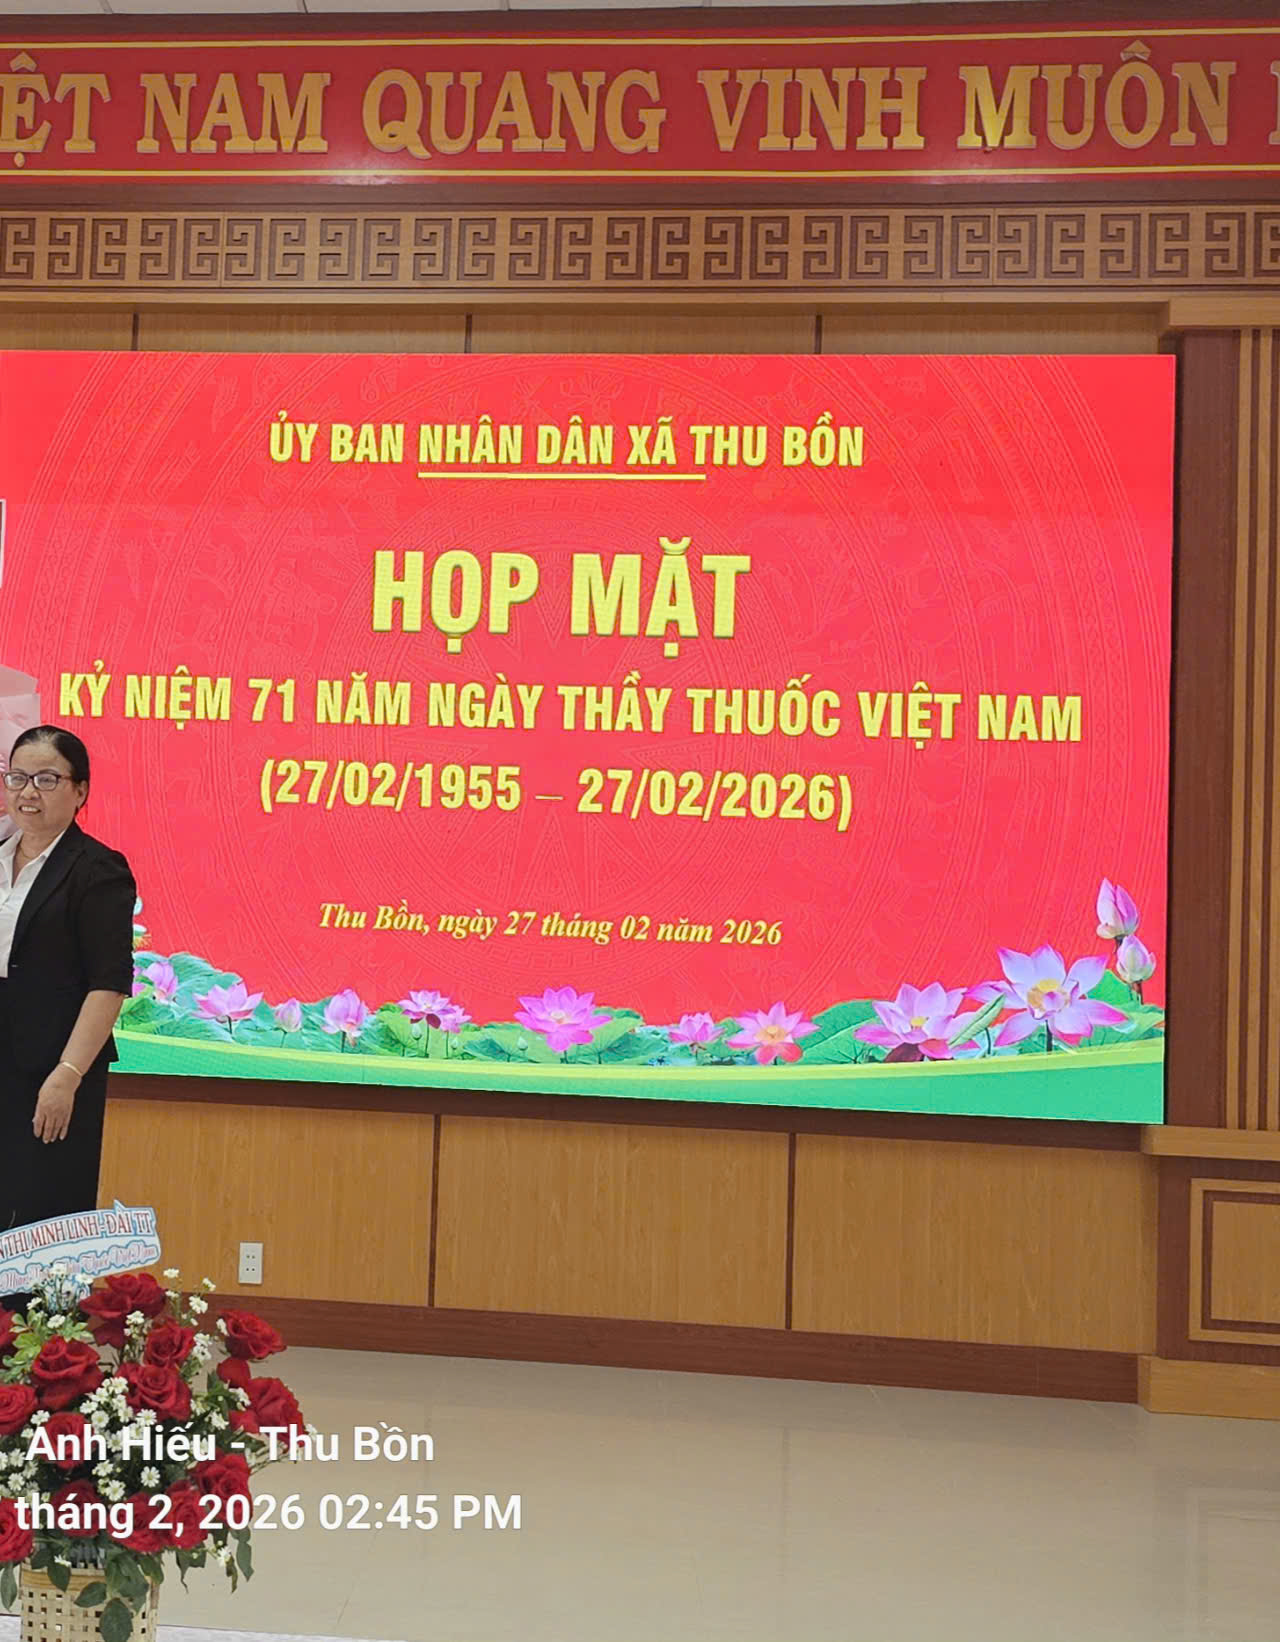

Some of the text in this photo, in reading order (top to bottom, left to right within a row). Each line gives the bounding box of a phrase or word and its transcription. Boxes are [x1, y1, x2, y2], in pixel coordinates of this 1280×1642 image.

[137, 72, 330, 153] NAM
[363, 69, 666, 159] QUANG
[697, 67, 927, 152] VINH
[956, 39, 1236, 150] MUÔN
[269, 408, 865, 468] ỦY BAN NHÂN DÂN XÃ THU BỒN
[372, 536, 752, 659] HỌP MẶT
[59, 660, 1083, 750] KỶ NIỆM 71 NĂM NGÀY THẦY THUỐC VIỆT NAM
[260, 758, 522, 814] (27/02/1955
[577, 767, 854, 833] 27/02/2026)
[319, 899, 784, 946] Thu Bồn, ngày 27 tháng 02 năm 2026
[30, 1221, 66, 1249] MINH
[134, 1212, 151, 1234] TT
